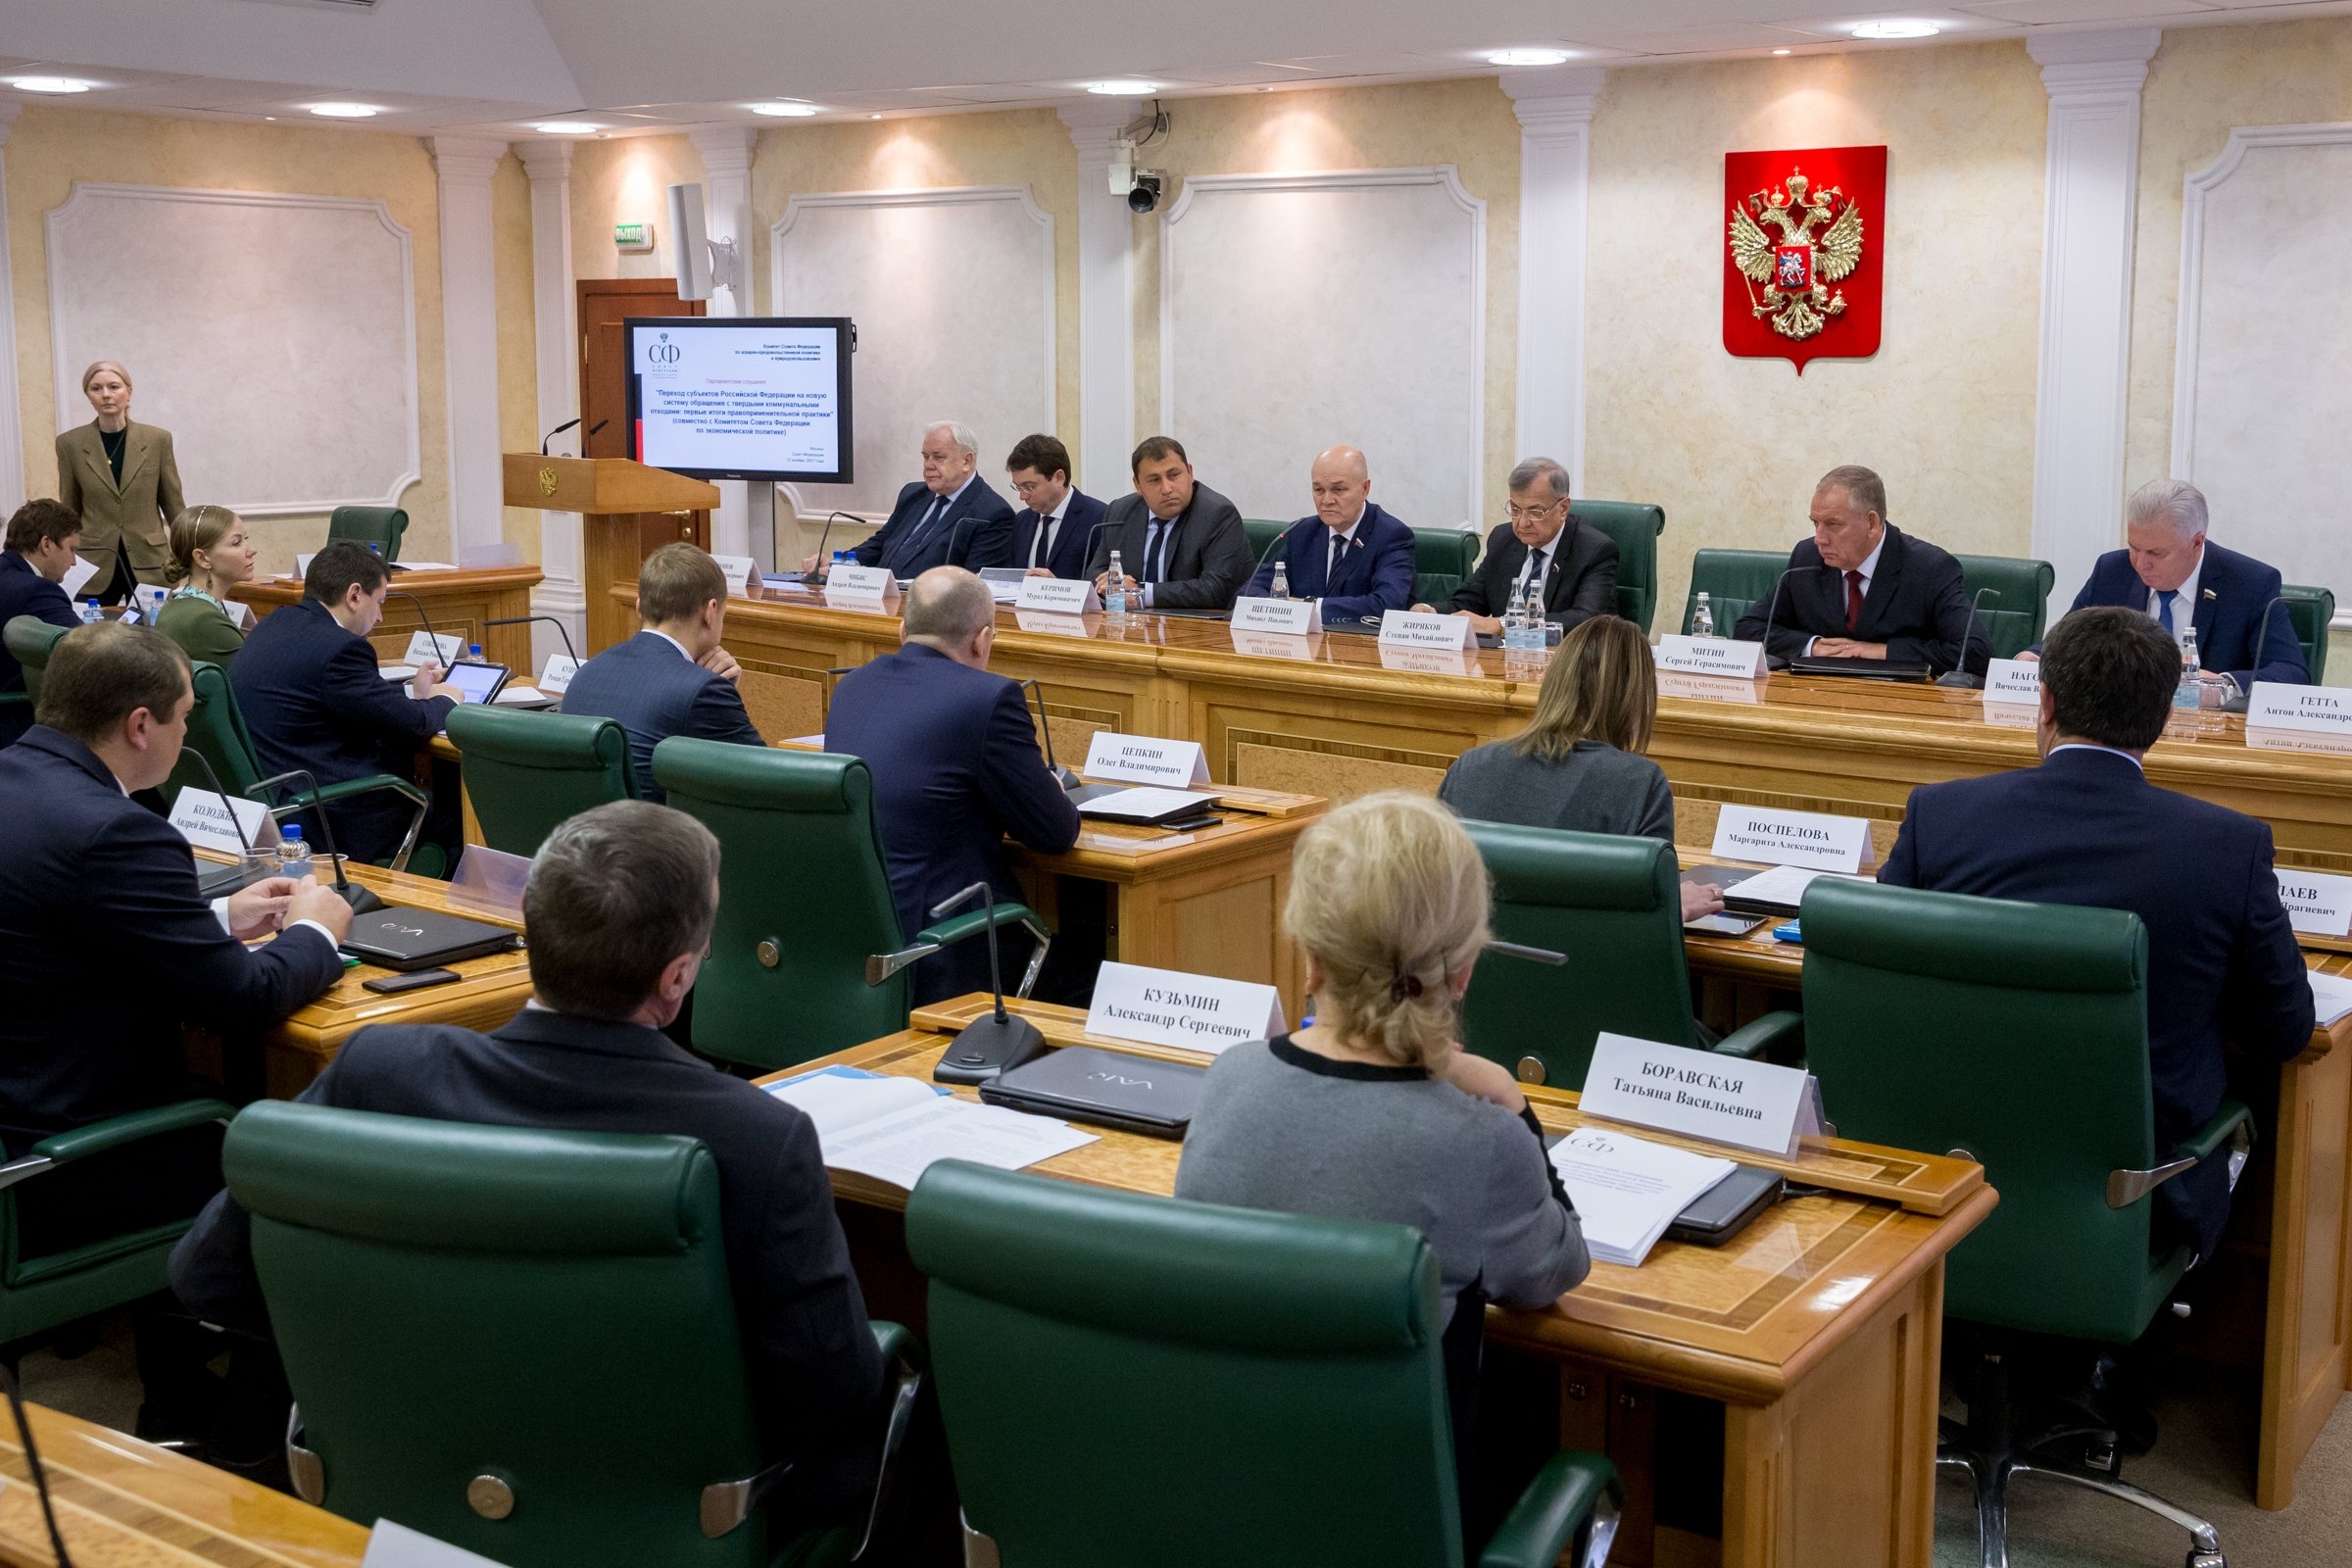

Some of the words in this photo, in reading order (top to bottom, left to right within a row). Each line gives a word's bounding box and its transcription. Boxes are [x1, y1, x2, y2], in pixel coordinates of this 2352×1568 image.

[615, 227, 643, 241] ВЫХОД
[649, 344, 680, 364] СФ
[1040, 584, 1072, 594] КЕРИМОВ
[1251, 605, 1293, 615] ЩЕТИНИН
[1402, 621, 1442, 631] ЖИРЯКОВ
[1386, 630, 1409, 639] Степан
[1411, 632, 1454, 643] Михайлович
[422, 639, 448, 650] СОКООВА
[1691, 647, 1726, 658] МИТИН
[1665, 656, 1692, 666] Сергей
[1693, 659, 1746, 670] Герасимович
[2011, 671, 2039, 681] НАГО
[1995, 682, 2032, 692] Вячеслав
[2300, 696, 2338, 708] ГЕТТА
[2264, 707, 2294, 716] Антон
[2297, 710, 2352, 722] Александро
[1121, 747, 1163, 760] ЦЕПКИН
[1097, 757, 1118, 767] Олег
[1119, 760, 1181, 775] Владимирович
[193, 805, 238, 821] КОЛОДКИ
[175, 817, 199, 830] Андрей
[199, 821, 240, 838] Вячеславови
[1747, 821, 1830, 841] ПОСПЕЛОВА
[1728, 834, 1776, 847] Маргарита
[1777, 841, 1845, 856] Александровна
[2278, 885, 2318, 900] ЛАЕВ
[1144, 988, 1221, 1012] КУЗЬМИН
[1103, 1004, 1175, 1029] Александр
[1179, 1014, 1251, 1039] Сергеевич
[1642, 1061, 1743, 1095] БОРАВСКАЯ
[1613, 1077, 1672, 1102] Татьяна
[1675, 1090, 1762, 1120] Васильевна
